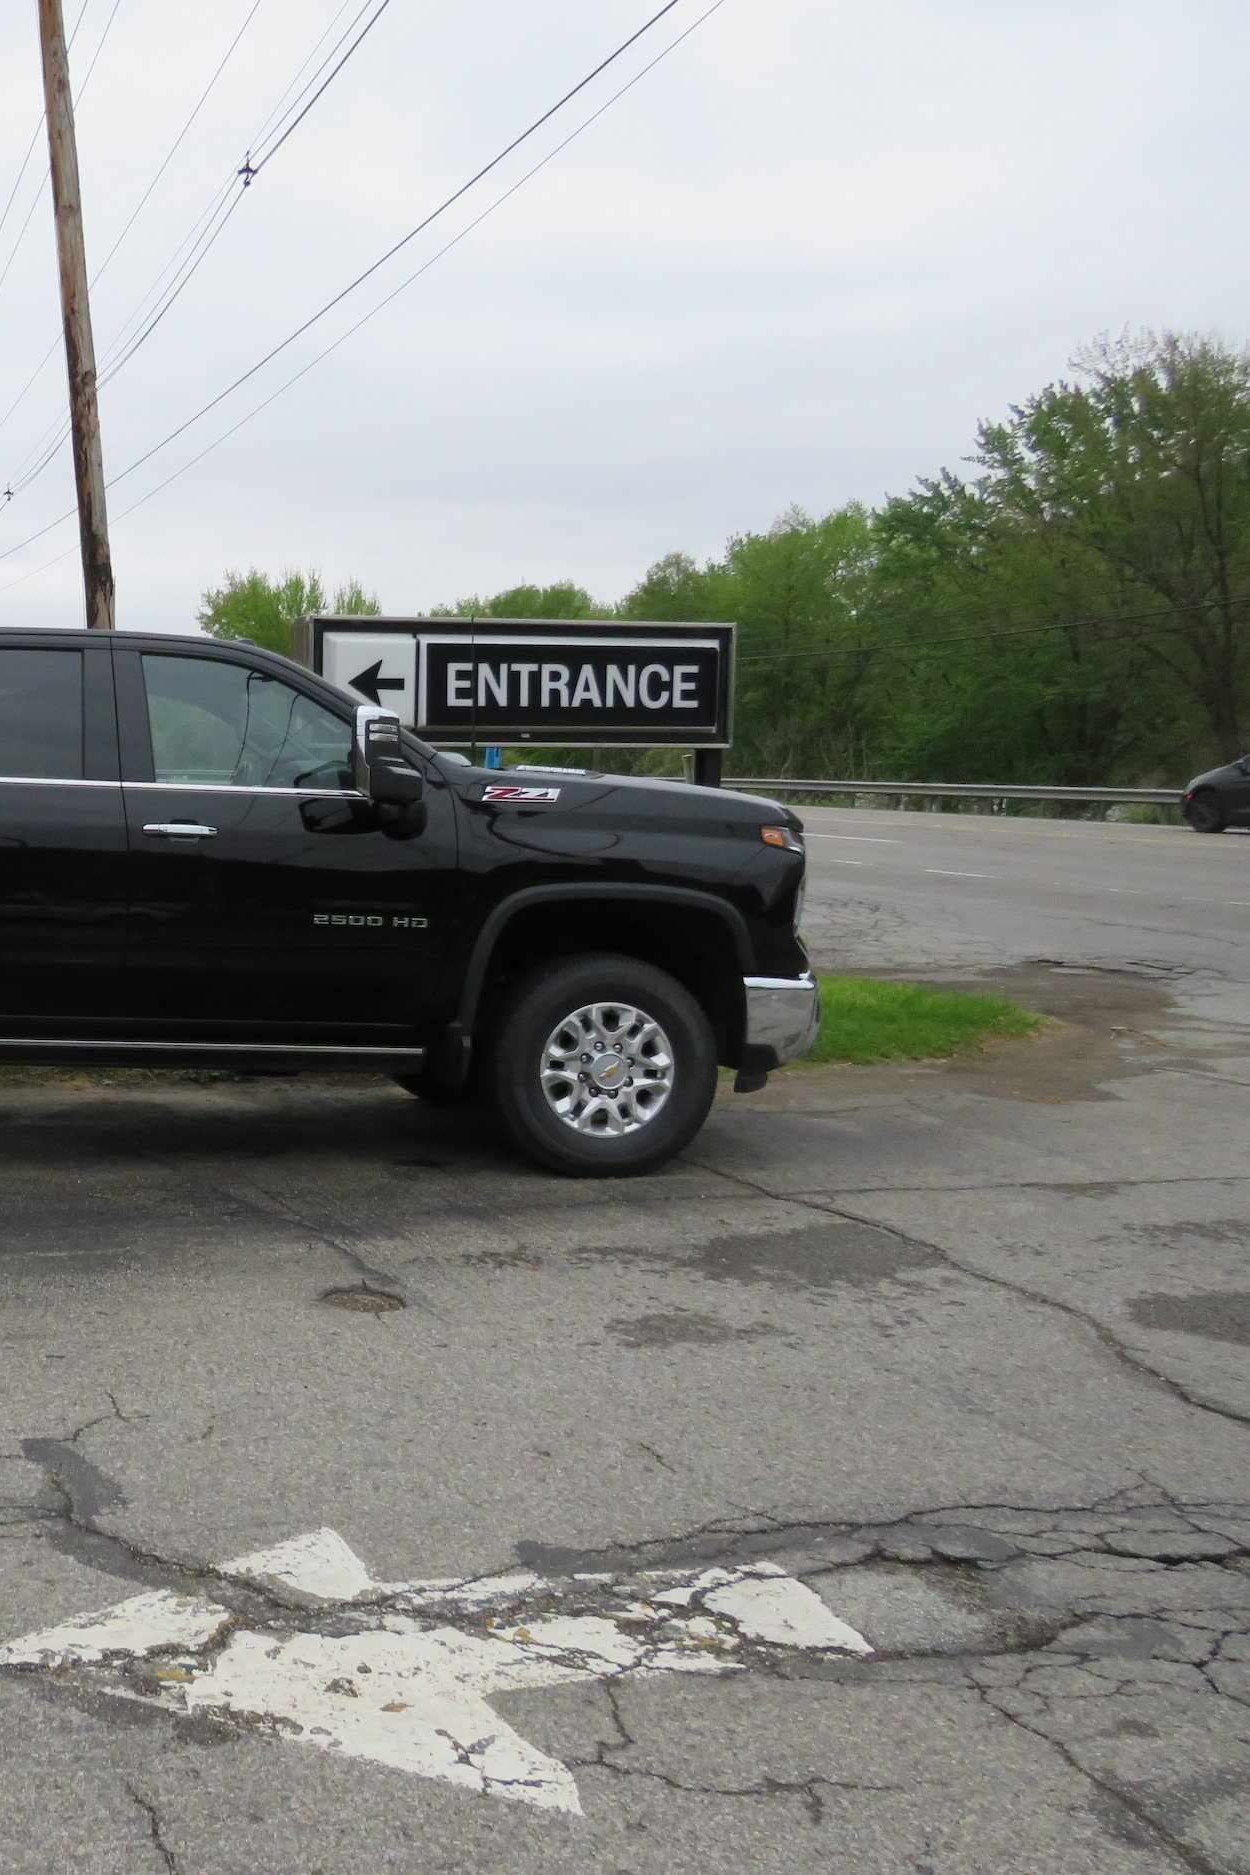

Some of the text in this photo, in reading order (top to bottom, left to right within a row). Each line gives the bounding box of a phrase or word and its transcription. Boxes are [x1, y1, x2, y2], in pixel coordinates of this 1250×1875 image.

[447, 662, 699, 709] ENTRANCE
[481, 786, 561, 803] Z71
[313, 914, 428, 928] 2500 HD
